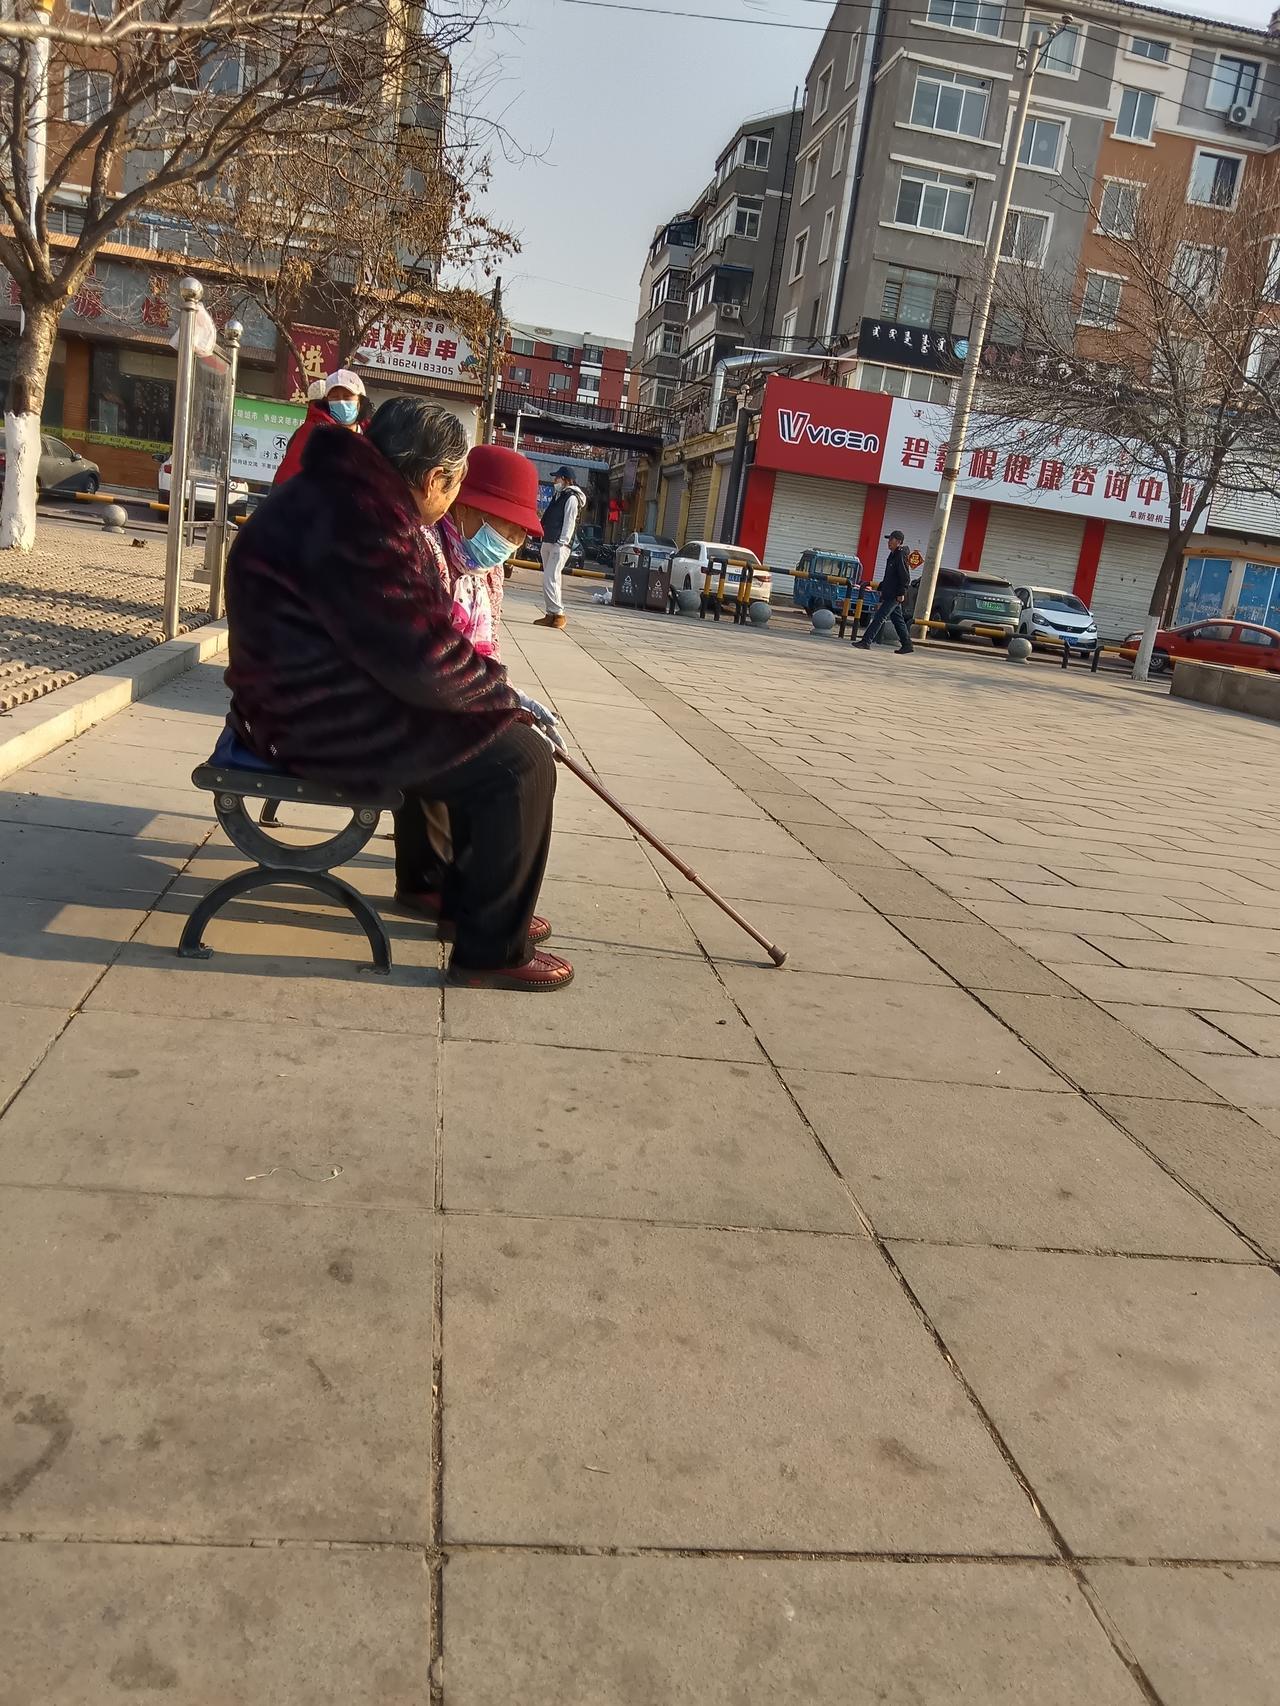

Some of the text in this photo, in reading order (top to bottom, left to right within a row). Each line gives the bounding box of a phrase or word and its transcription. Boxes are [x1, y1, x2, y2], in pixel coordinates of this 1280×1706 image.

[388, 356, 454, 376] 18624183305
[1129, 509, 1190, 528] 阜新碧根三店
